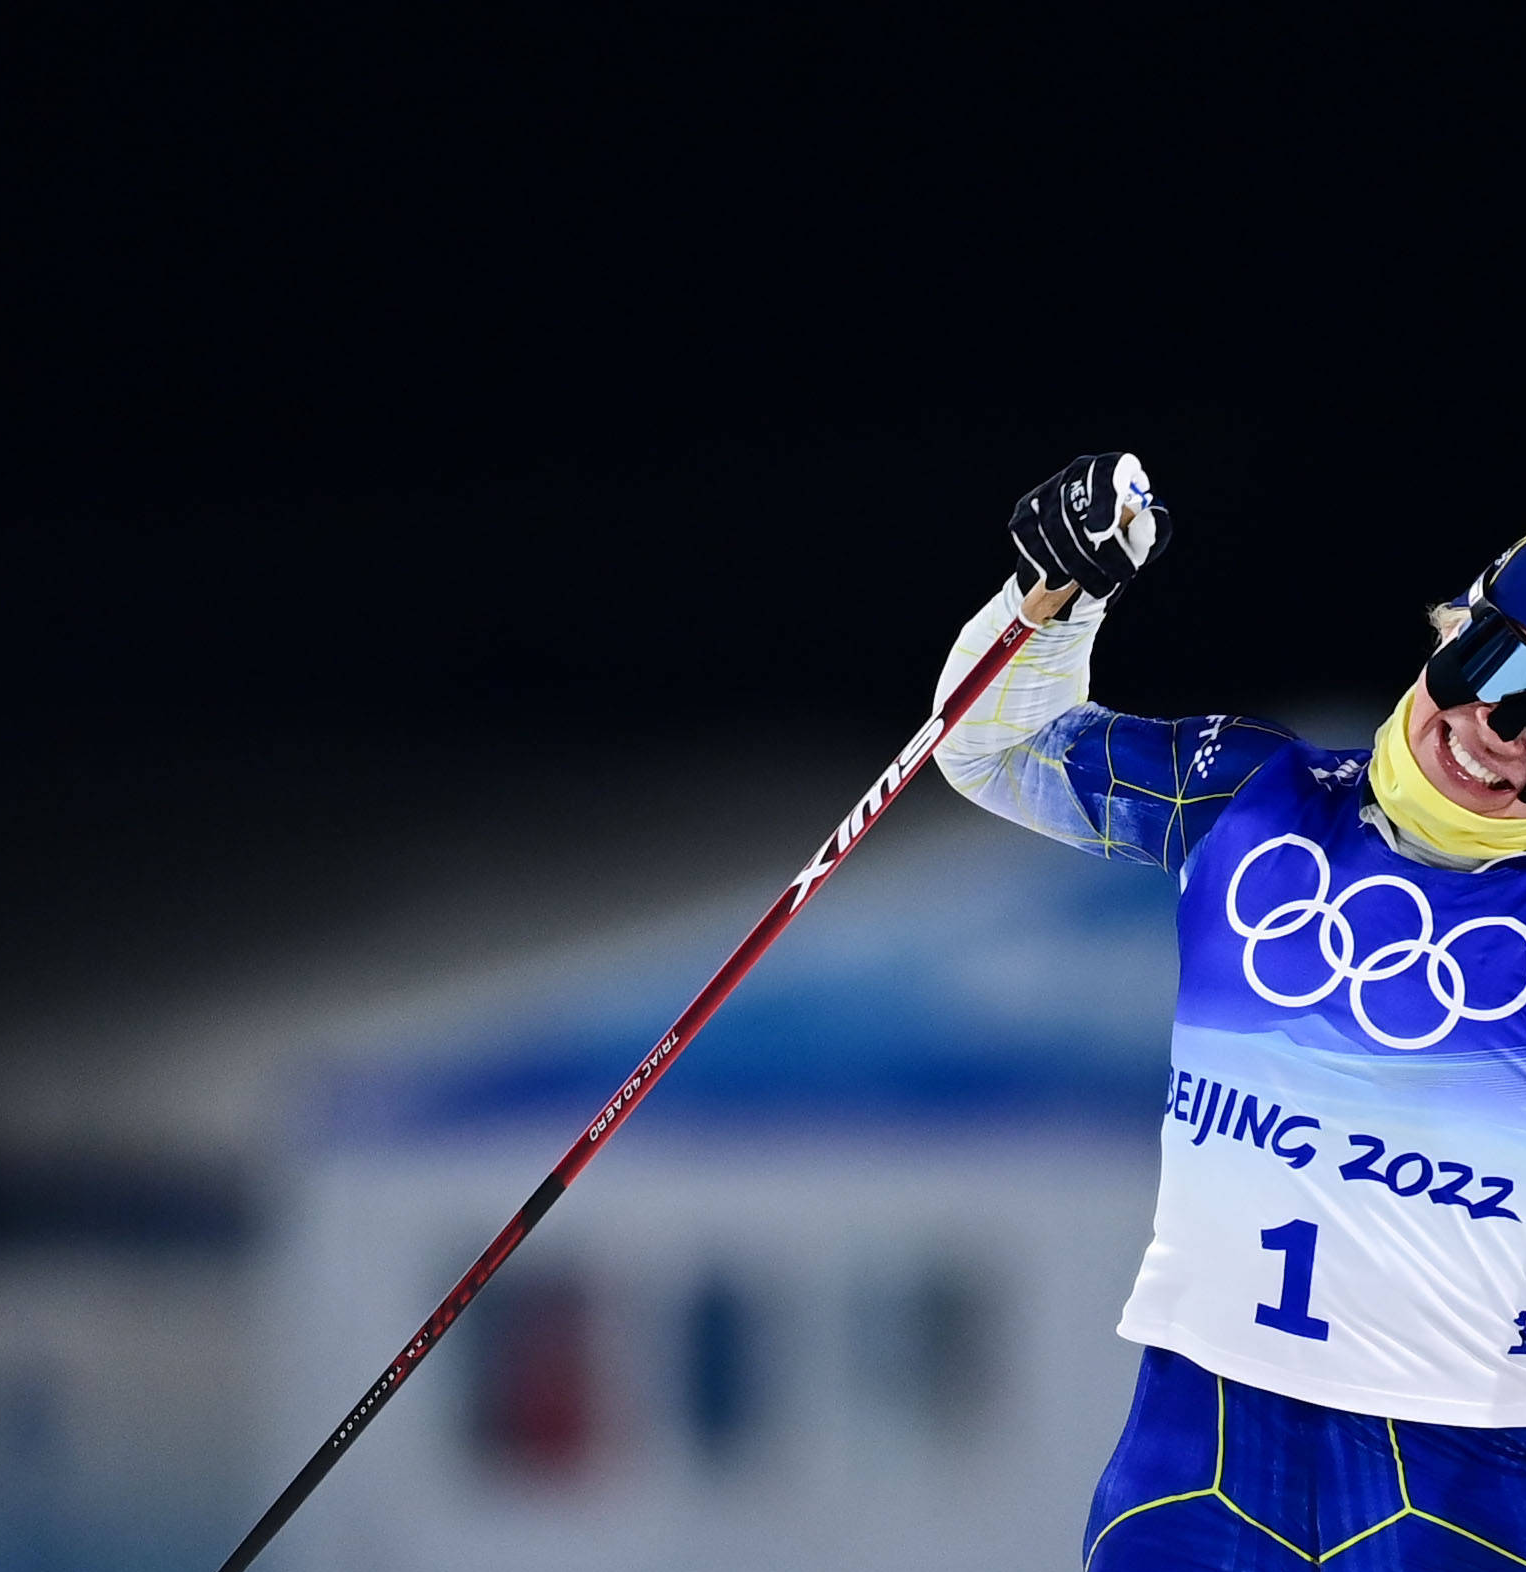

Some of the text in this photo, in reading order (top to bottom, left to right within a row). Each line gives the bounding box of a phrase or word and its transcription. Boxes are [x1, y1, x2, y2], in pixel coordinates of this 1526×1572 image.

[1003, 625, 1024, 647] TCS
[789, 718, 945, 914] SWIX
[641, 1031, 679, 1079] TRIAC
[589, 1095, 622, 1142] AERO
[1166, 1066, 1521, 1222] EIJING 2022
[1254, 1218, 1329, 1342] 1
[334, 1366, 402, 1447] TECHNOLOGY
